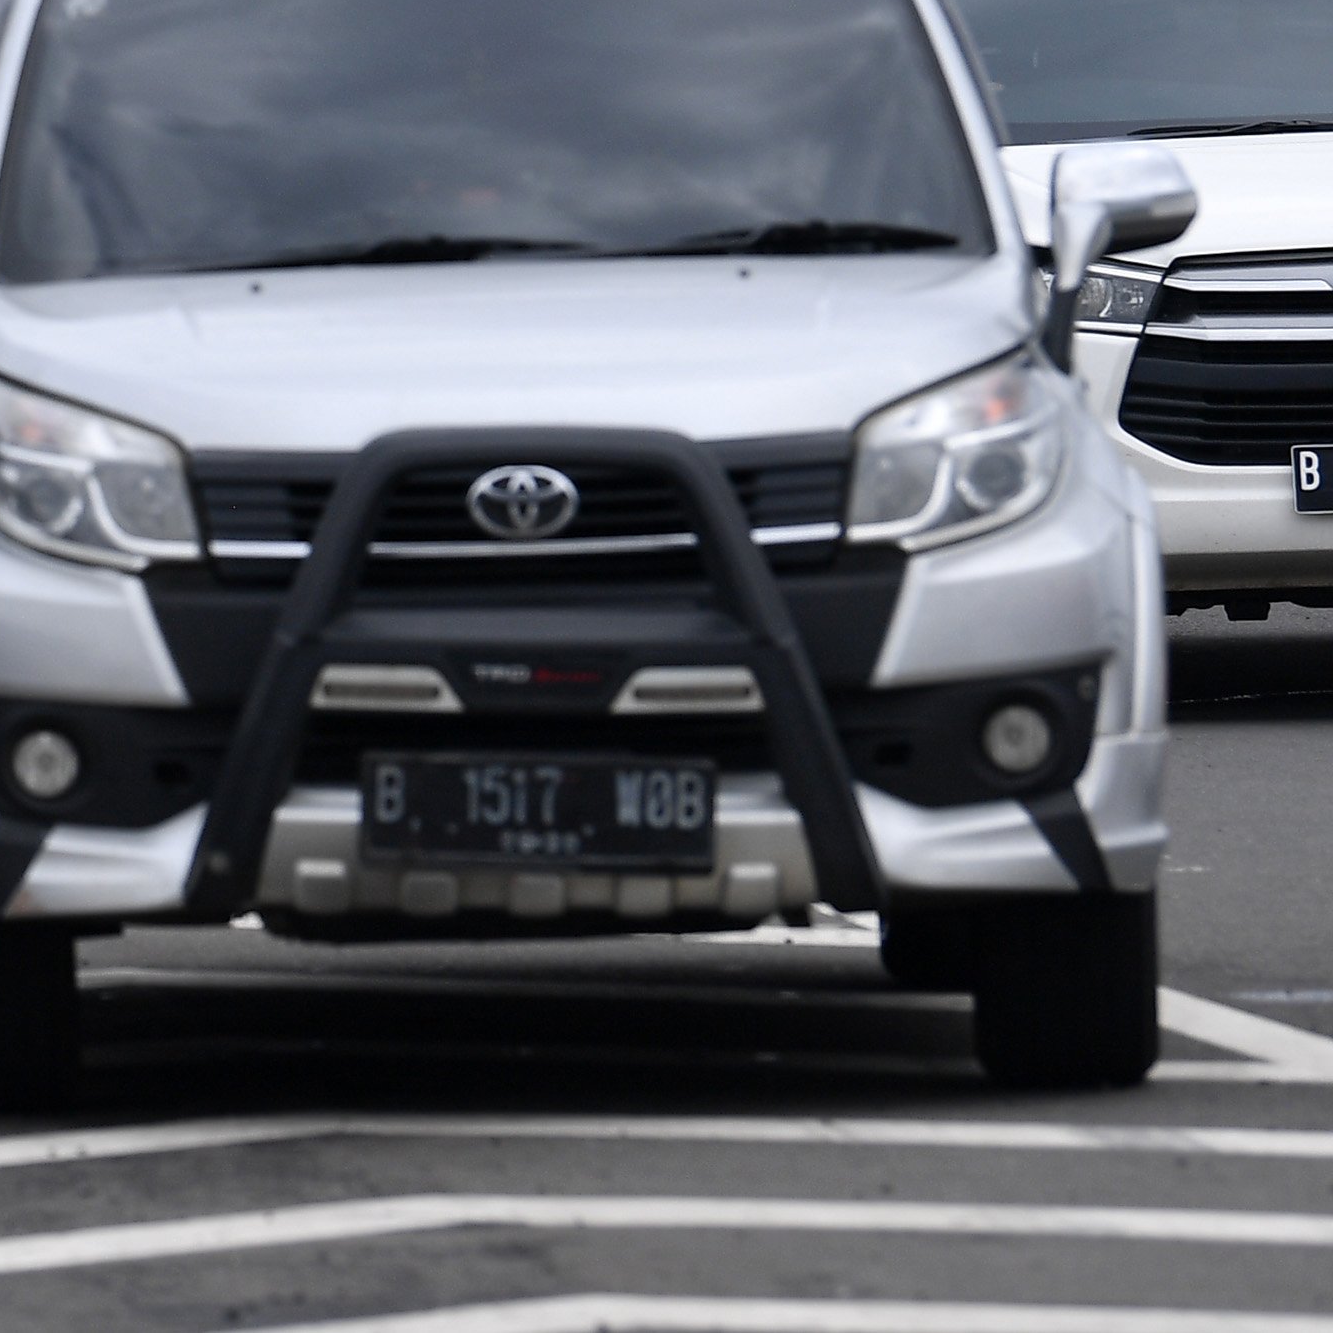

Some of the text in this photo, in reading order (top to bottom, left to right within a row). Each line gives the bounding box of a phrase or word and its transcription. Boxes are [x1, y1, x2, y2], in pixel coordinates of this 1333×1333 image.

[1299, 450, 1321, 491] B
[374, 765, 407, 824] B
[463, 765, 564, 827] 1517
